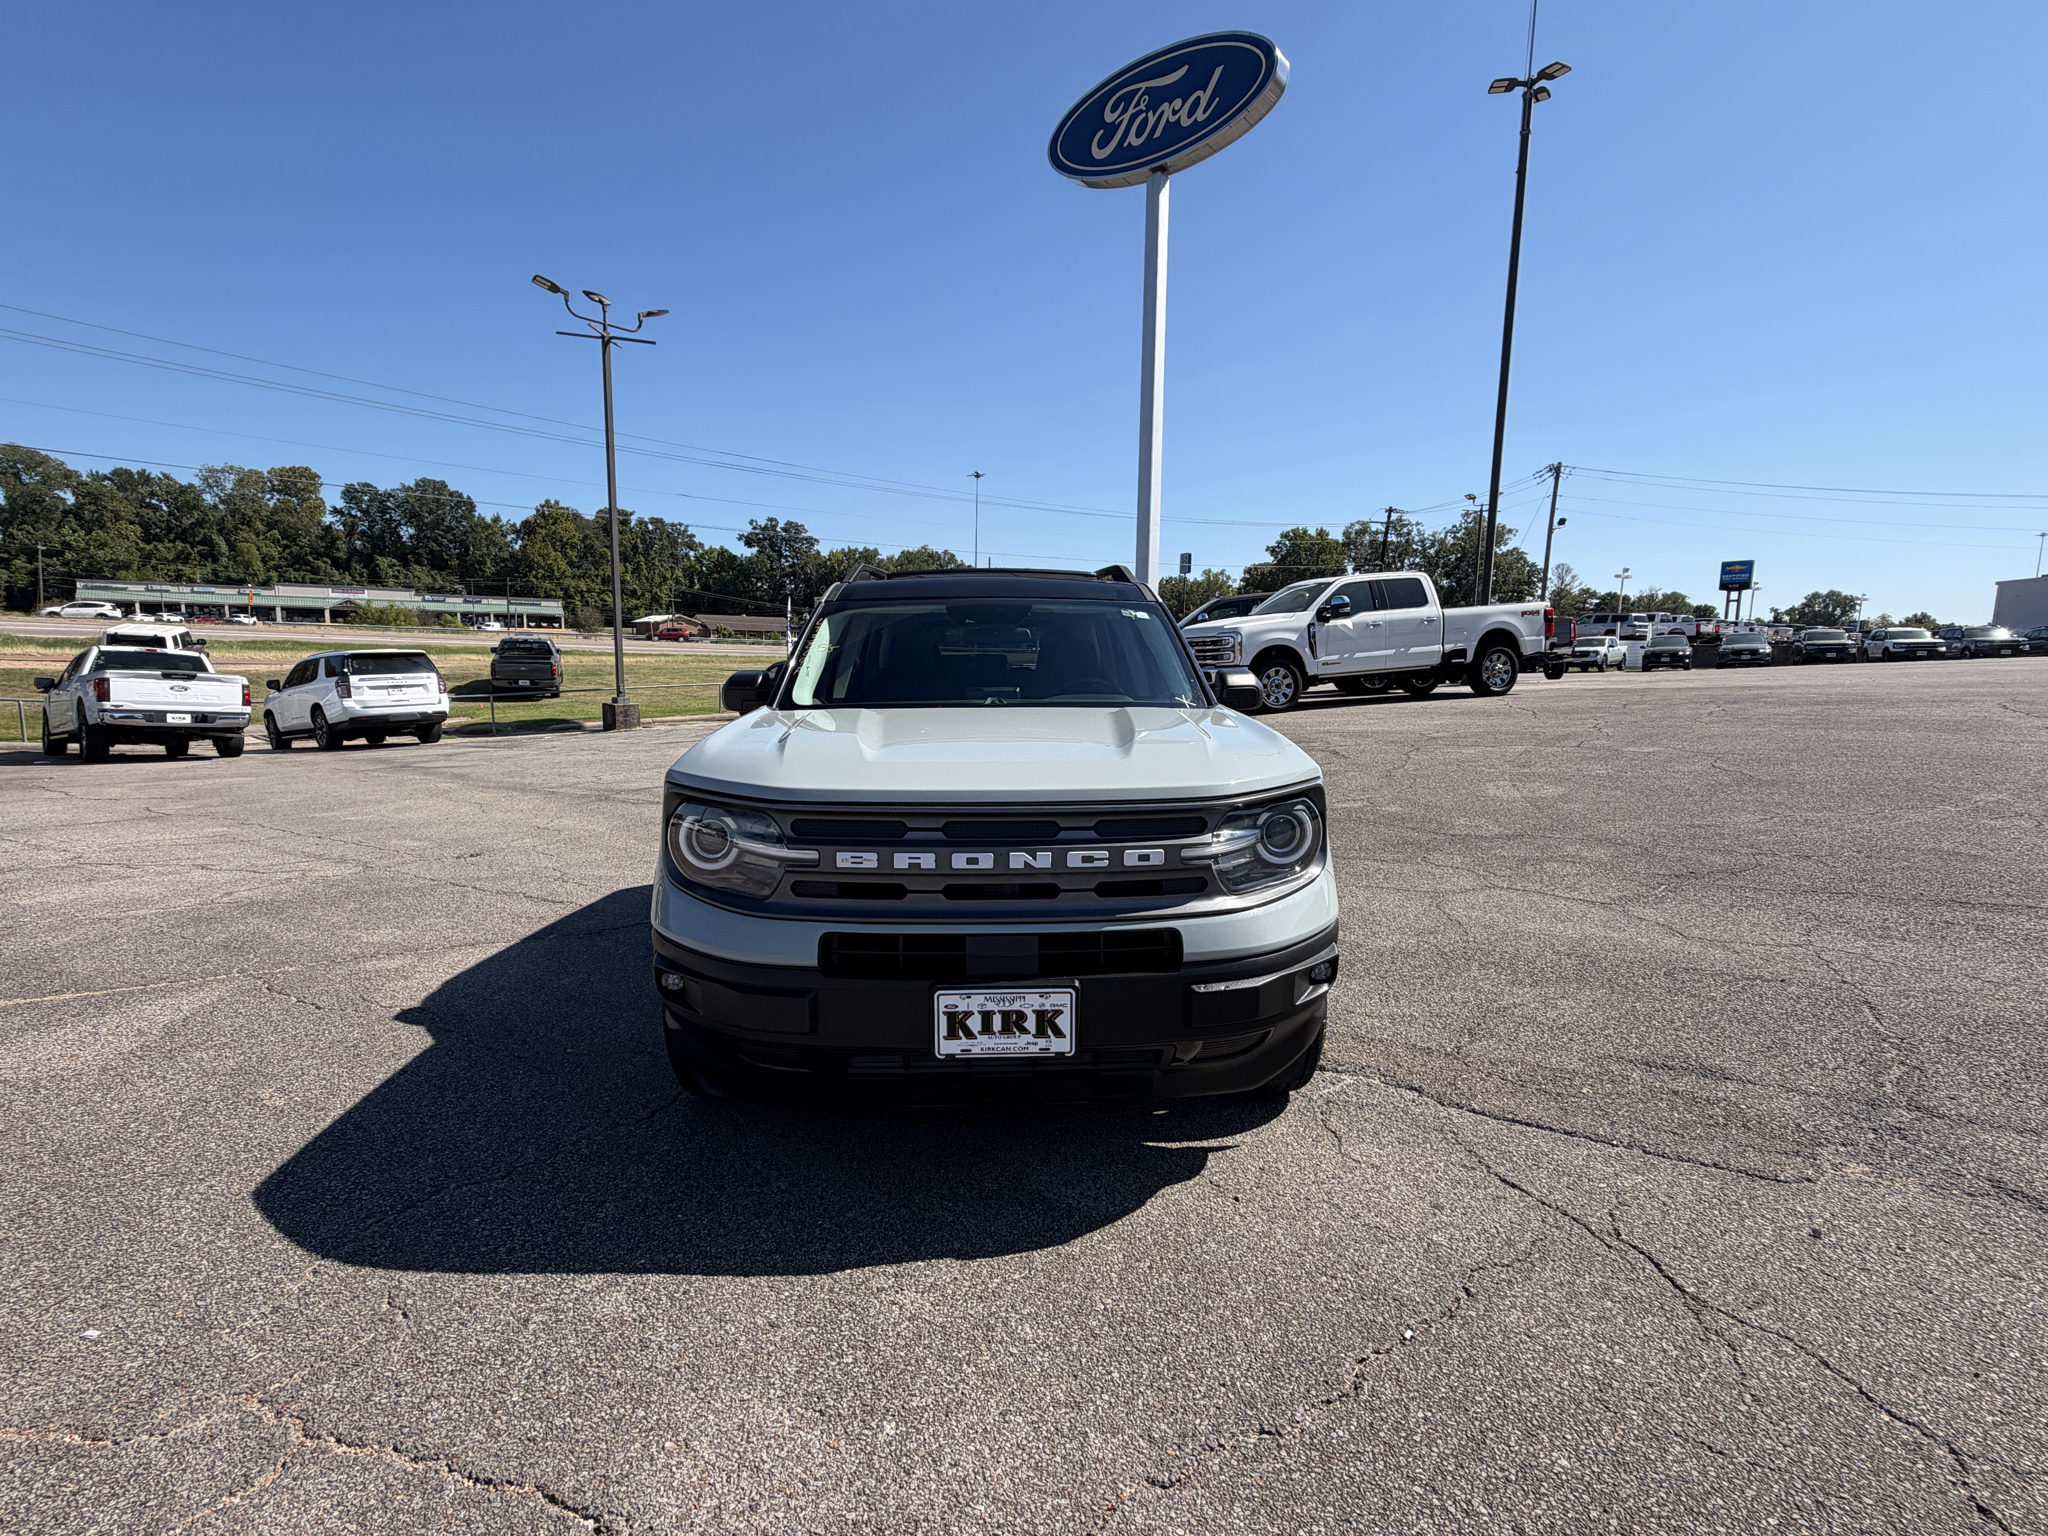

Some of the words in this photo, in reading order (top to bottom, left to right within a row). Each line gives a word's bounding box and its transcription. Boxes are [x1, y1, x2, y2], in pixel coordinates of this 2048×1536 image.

[1090, 64, 1225, 160] Ford
[1520, 609, 1540, 618] FX4
[835, 848, 1166, 870] BRONCO
[983, 995, 1026, 1008] MISSISSIPPI
[941, 1009, 1067, 1041] KIRK
